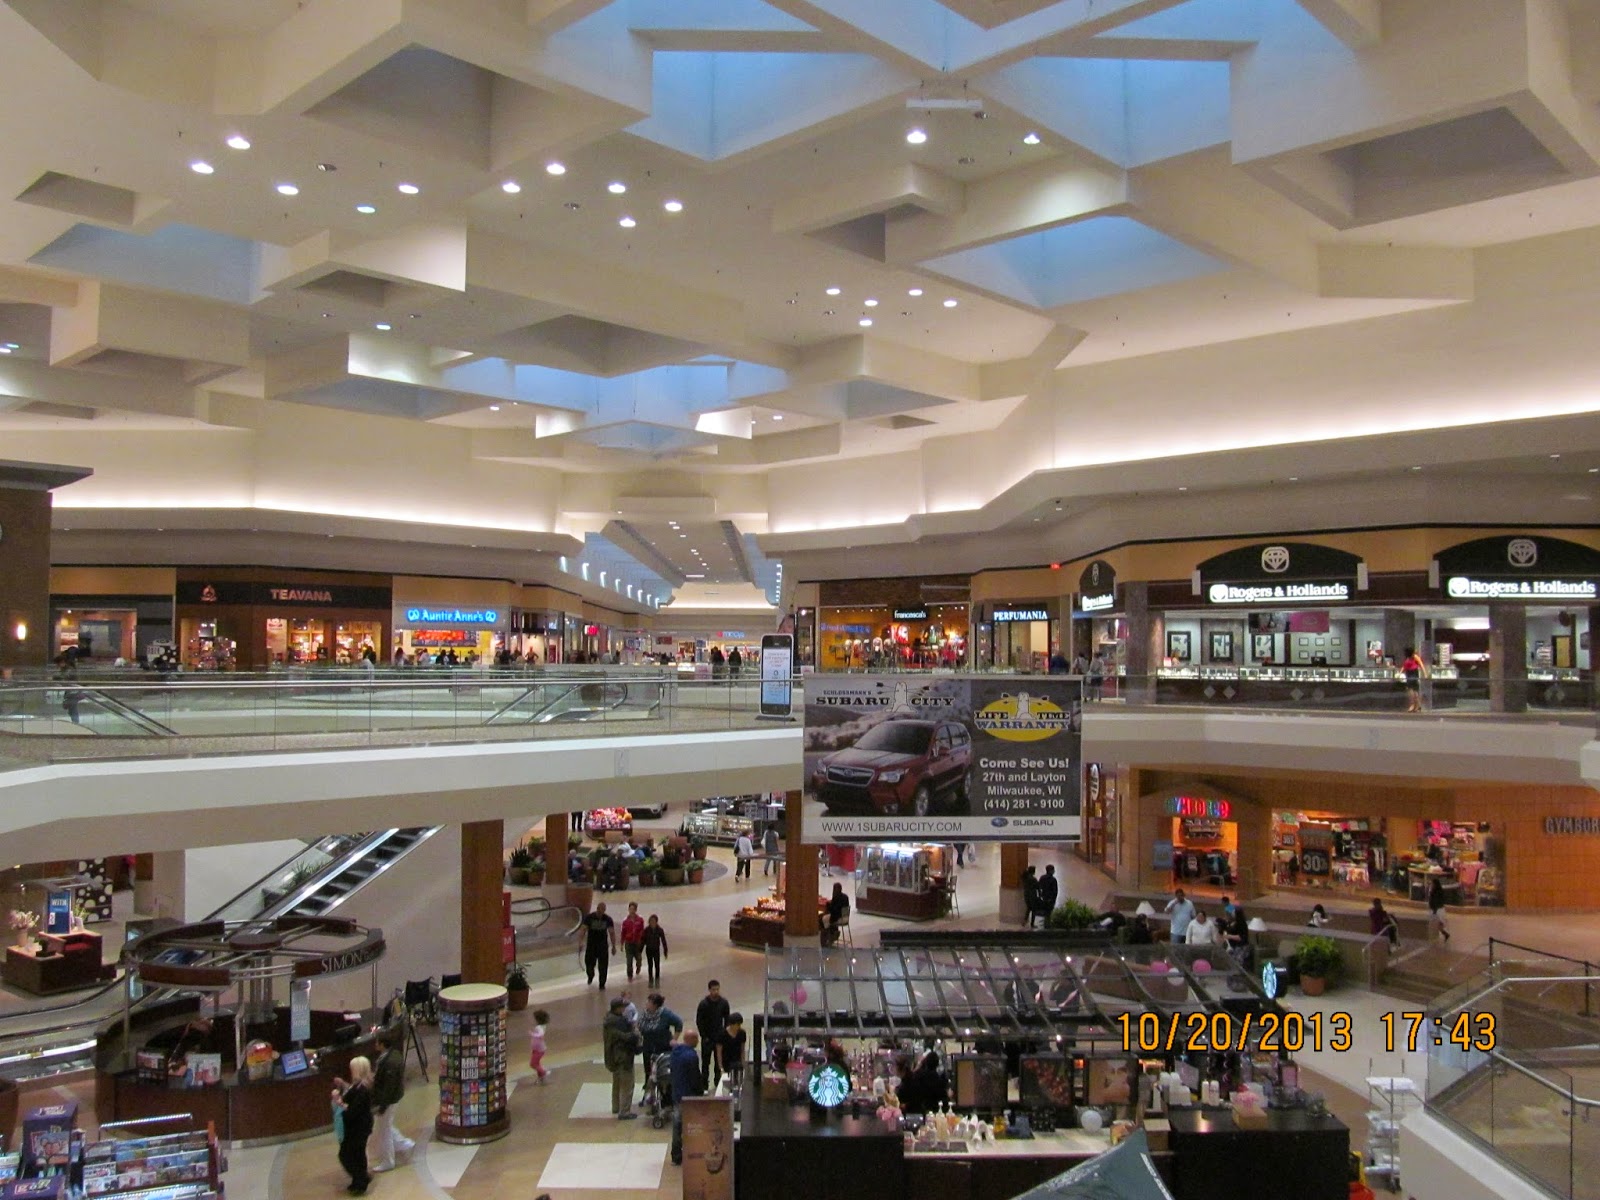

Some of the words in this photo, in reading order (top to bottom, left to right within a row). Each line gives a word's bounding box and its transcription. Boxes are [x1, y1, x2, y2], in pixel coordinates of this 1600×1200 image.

[1228, 586, 1273, 602] Rogers
[1274, 586, 1284, 597] &
[1286, 583, 1348, 596] Hollands
[1470, 581, 1519, 597] Rogers
[1520, 582, 1531, 593] &
[1533, 581, 1596, 593] Hollands
[270, 589, 333, 602] TEAVANA
[422, 609, 452, 621] Auntie
[454, 610, 484, 622] Anne's
[993, 611, 1048, 620] PERFUMANIA
[816, 697, 890, 706] SUBARU
[911, 697, 954, 706] CITY
[975, 711, 1009, 720] LIFE
[1037, 711, 1070, 720] TIME
[975, 721, 1070, 729] WARRANTY
[980, 758, 1017, 769] Come
[1020, 758, 1045, 769] See
[1048, 758, 1069, 769] Us!
[982, 772, 1005, 782] 27th
[1008, 772, 1027, 782] and
[1030, 772, 1066, 784] Layton
[987, 785, 1045, 797] Milwaukee,
[1047, 785, 1062, 796] WI
[984, 799, 1010, 811] (414)
[1012, 799, 1030, 809] 281
[1040, 799, 1065, 809] 9100
[822, 822, 962, 832] WWW.1SUBARUCITY.COM
[321, 951, 363, 974] SIMON
